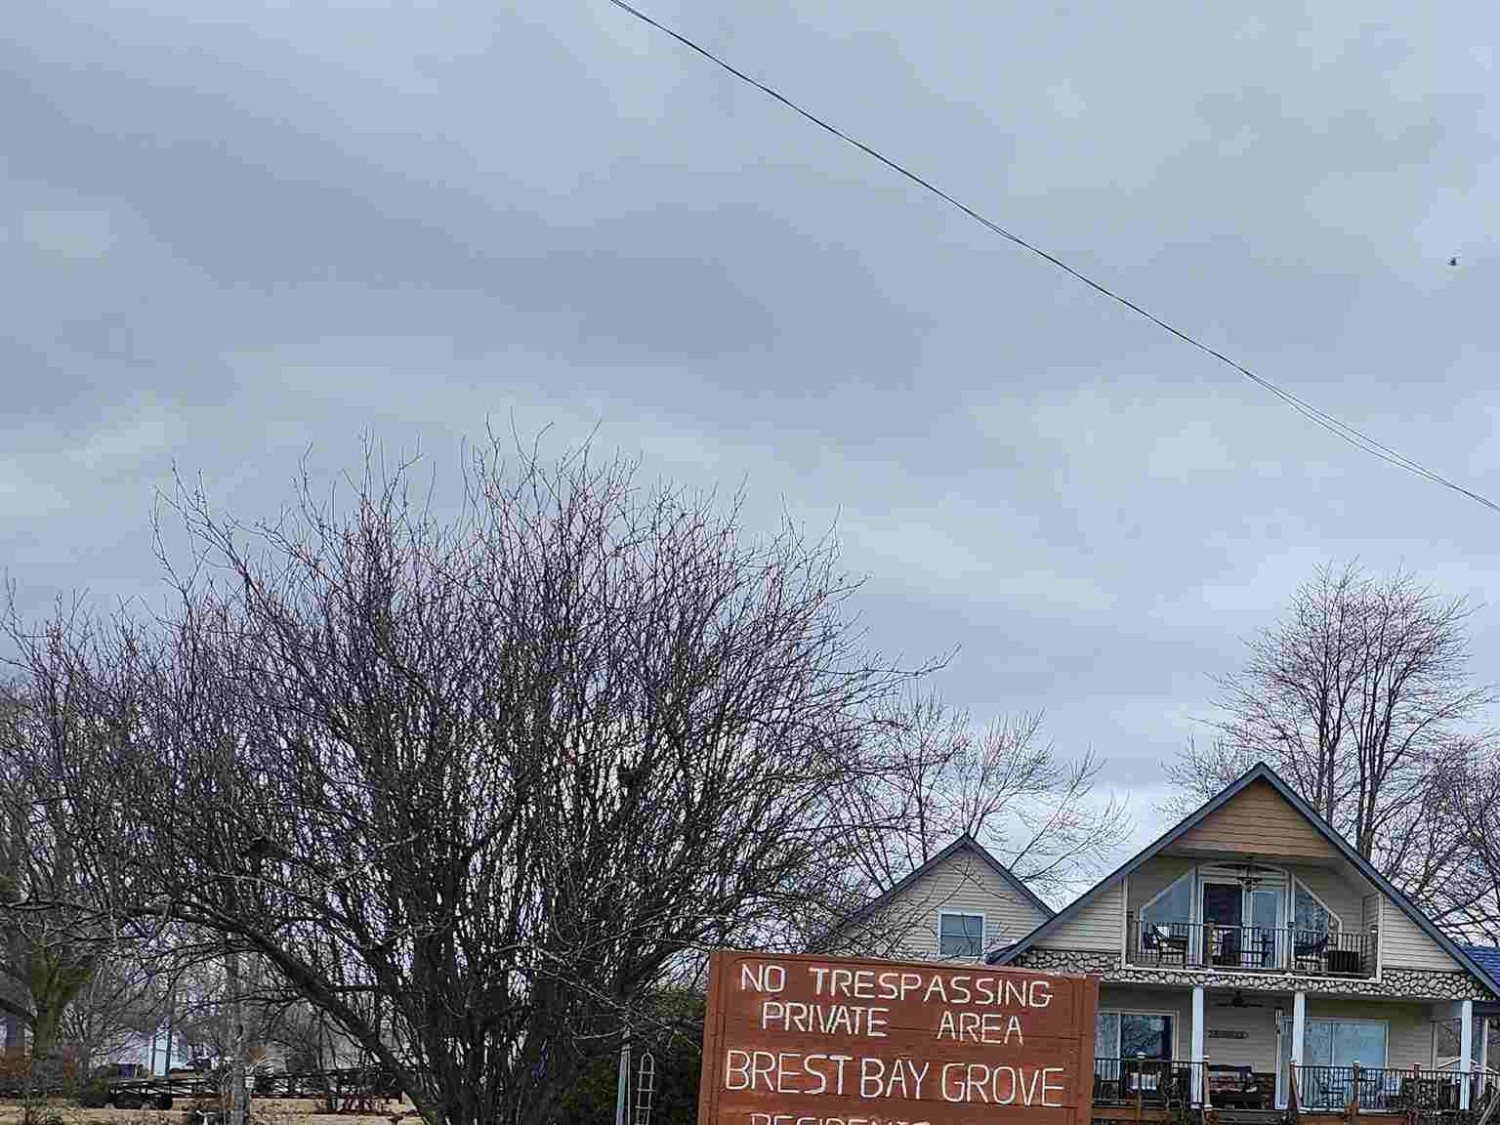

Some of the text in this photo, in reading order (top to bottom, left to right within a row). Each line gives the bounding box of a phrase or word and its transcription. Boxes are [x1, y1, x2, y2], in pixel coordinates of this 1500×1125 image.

[741, 964, 1053, 1007] NO TRESPASSING
[762, 1002, 1024, 1045] PRIVATE AREA
[725, 1049, 1064, 1107] BREST BAY GROVE
